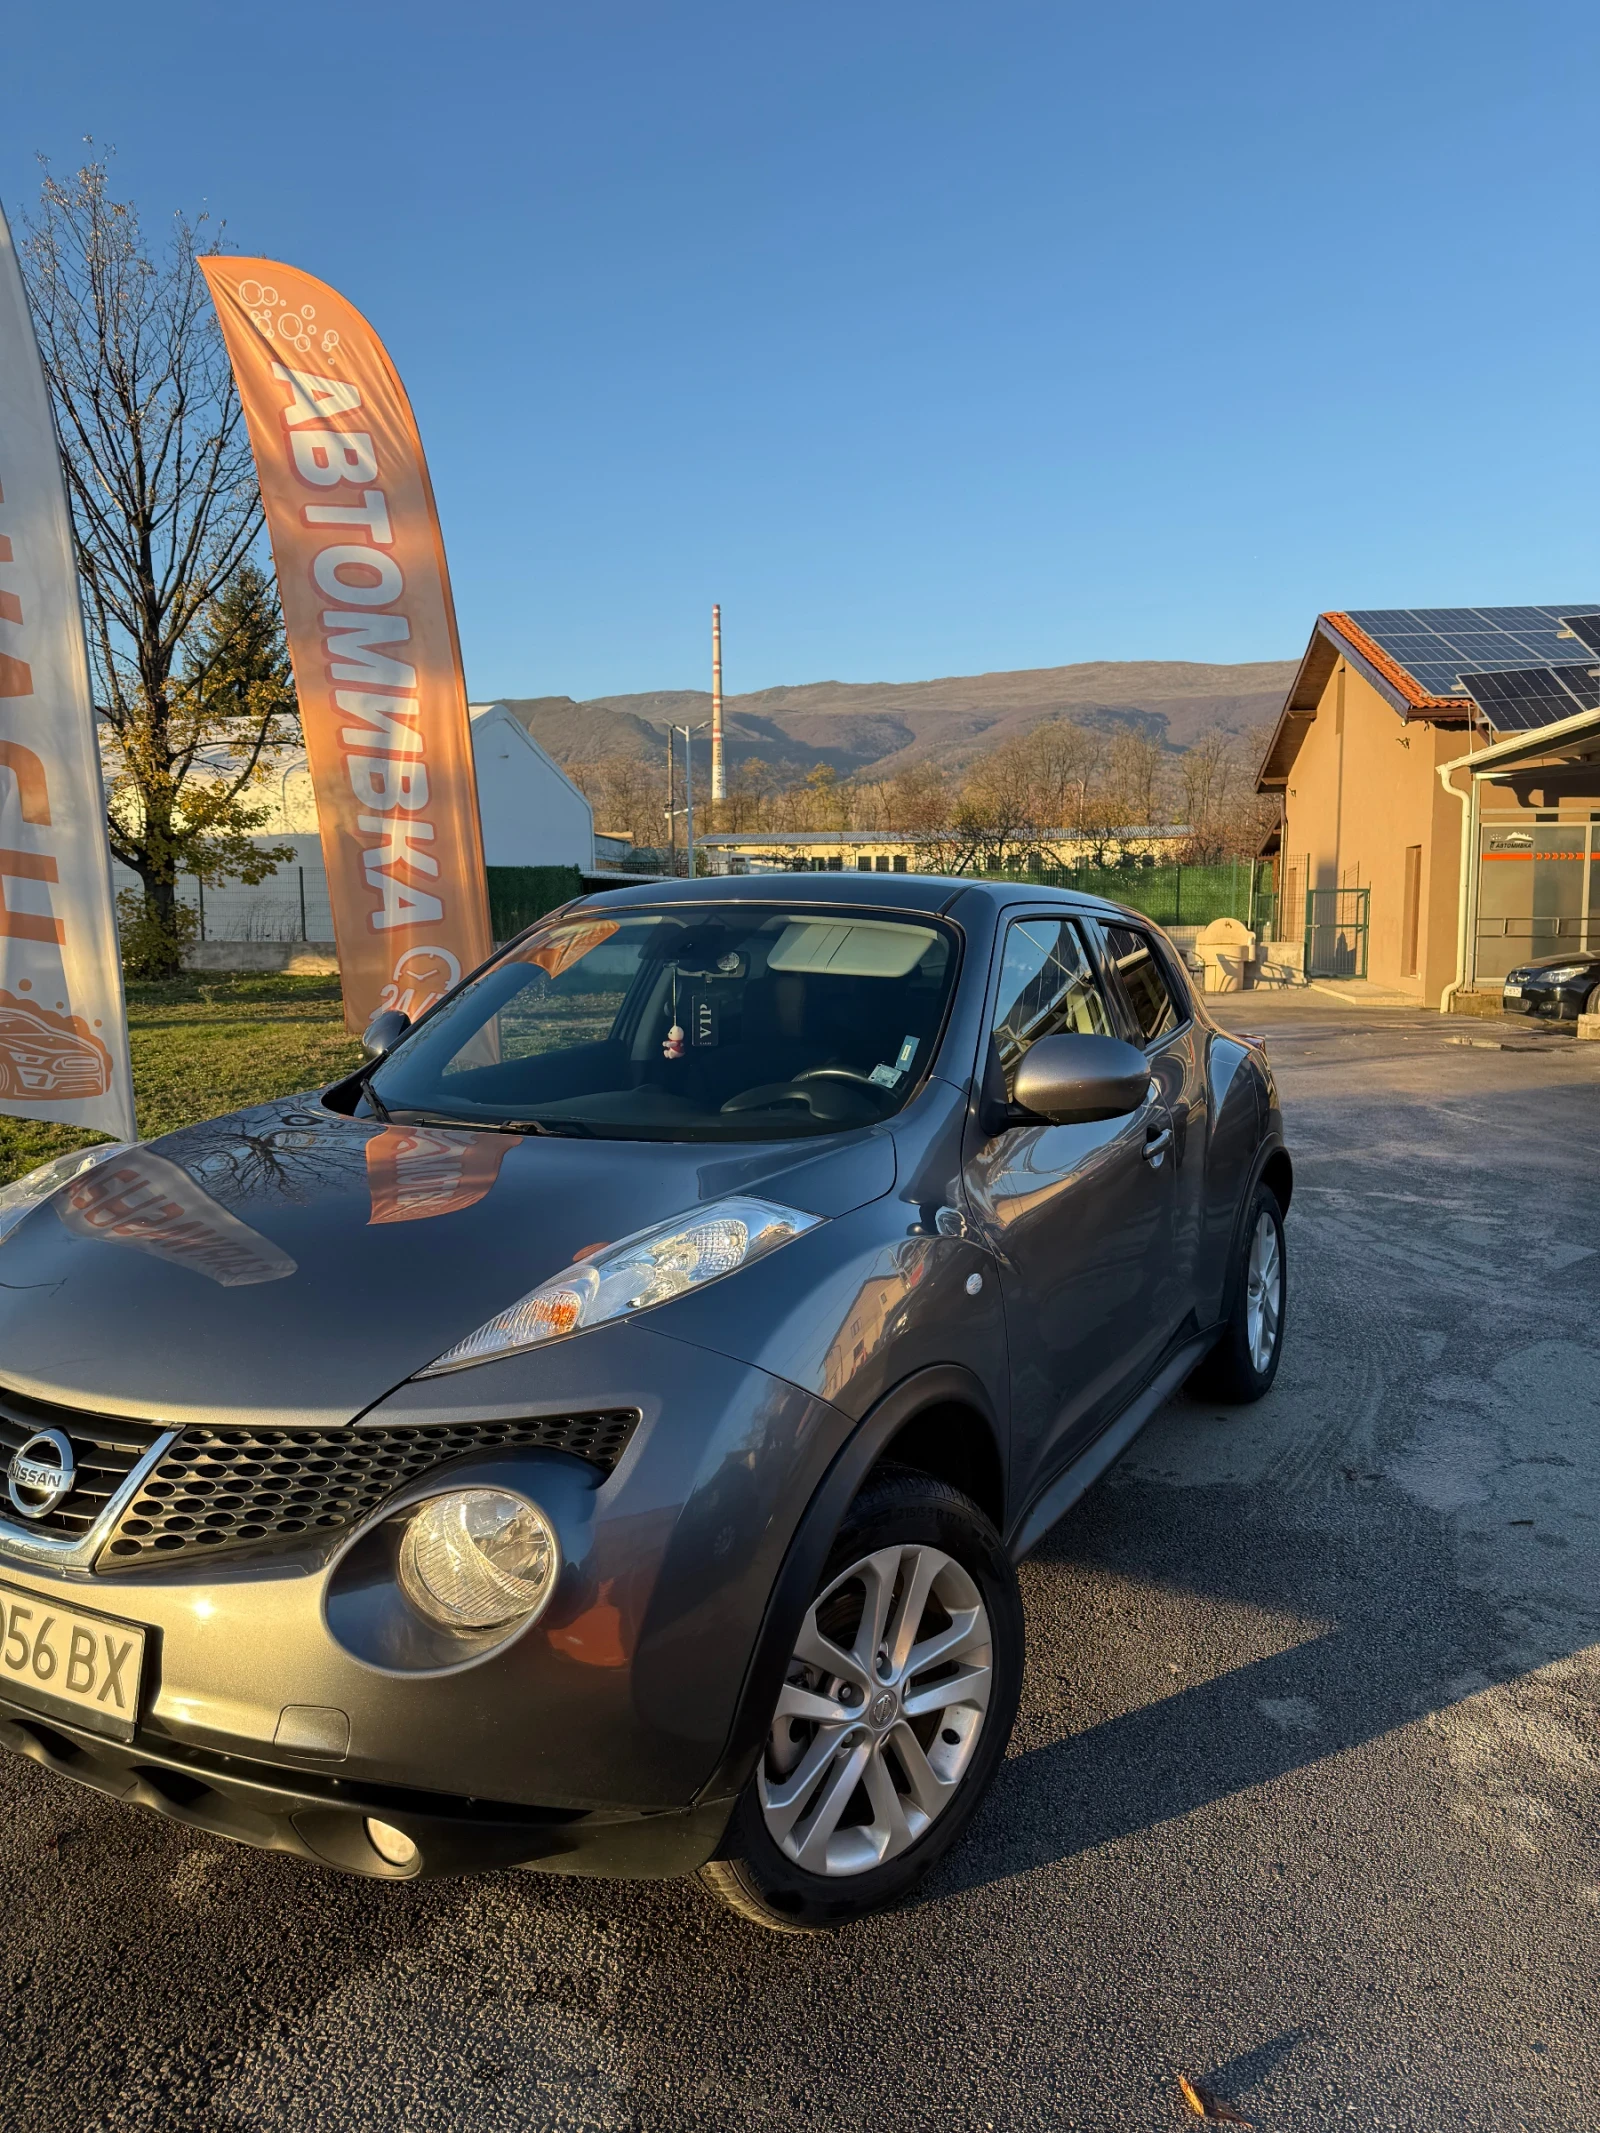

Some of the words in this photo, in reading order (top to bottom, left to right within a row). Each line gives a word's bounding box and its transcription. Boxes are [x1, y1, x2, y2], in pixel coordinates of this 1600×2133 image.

[271, 360, 445, 931] АВТОМИВКА
[369, 983, 447, 1024] 24/
[700, 1003, 711, 1038] VIP
[10, 1461, 62, 1487] NISSAN
